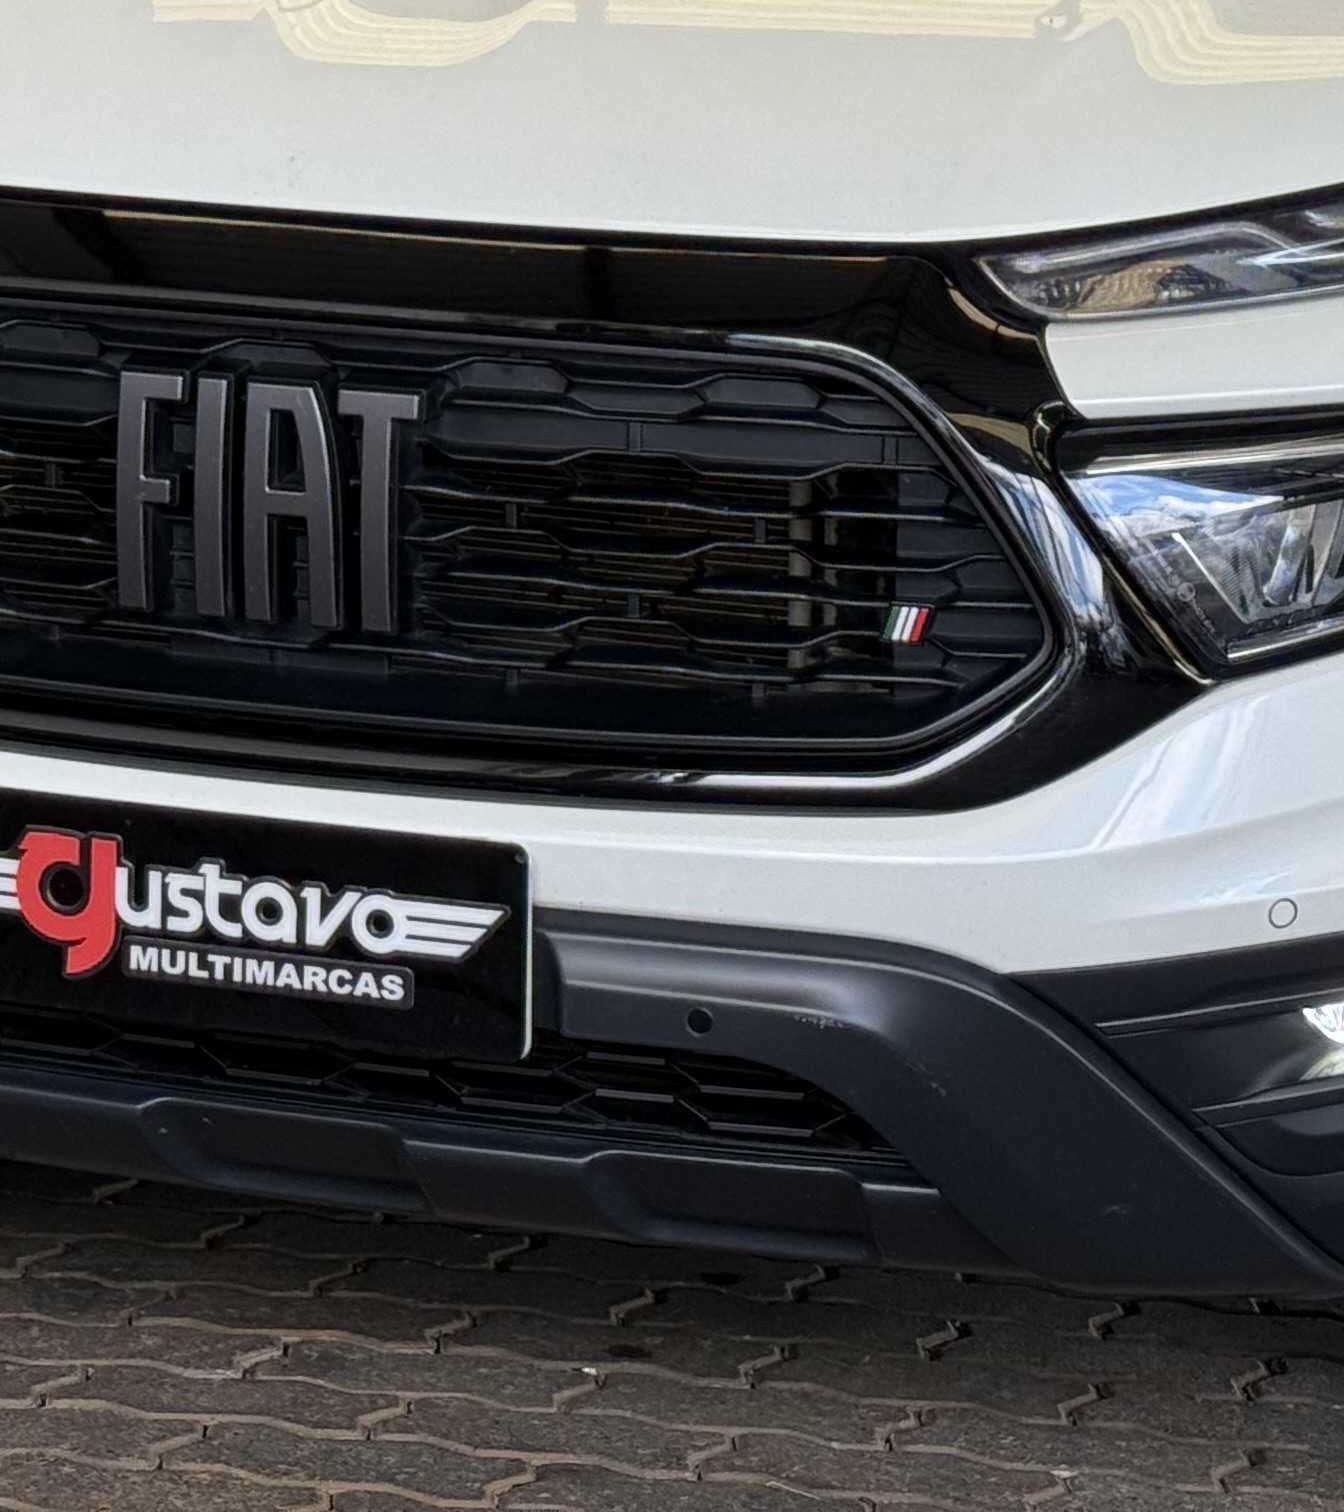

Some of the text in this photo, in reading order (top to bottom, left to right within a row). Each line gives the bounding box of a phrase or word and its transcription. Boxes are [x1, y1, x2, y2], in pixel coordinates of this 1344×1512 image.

[115, 368, 422, 634] FIAT
[14, 828, 409, 976] gustavo
[128, 944, 407, 1003] MULTIMARCAS
